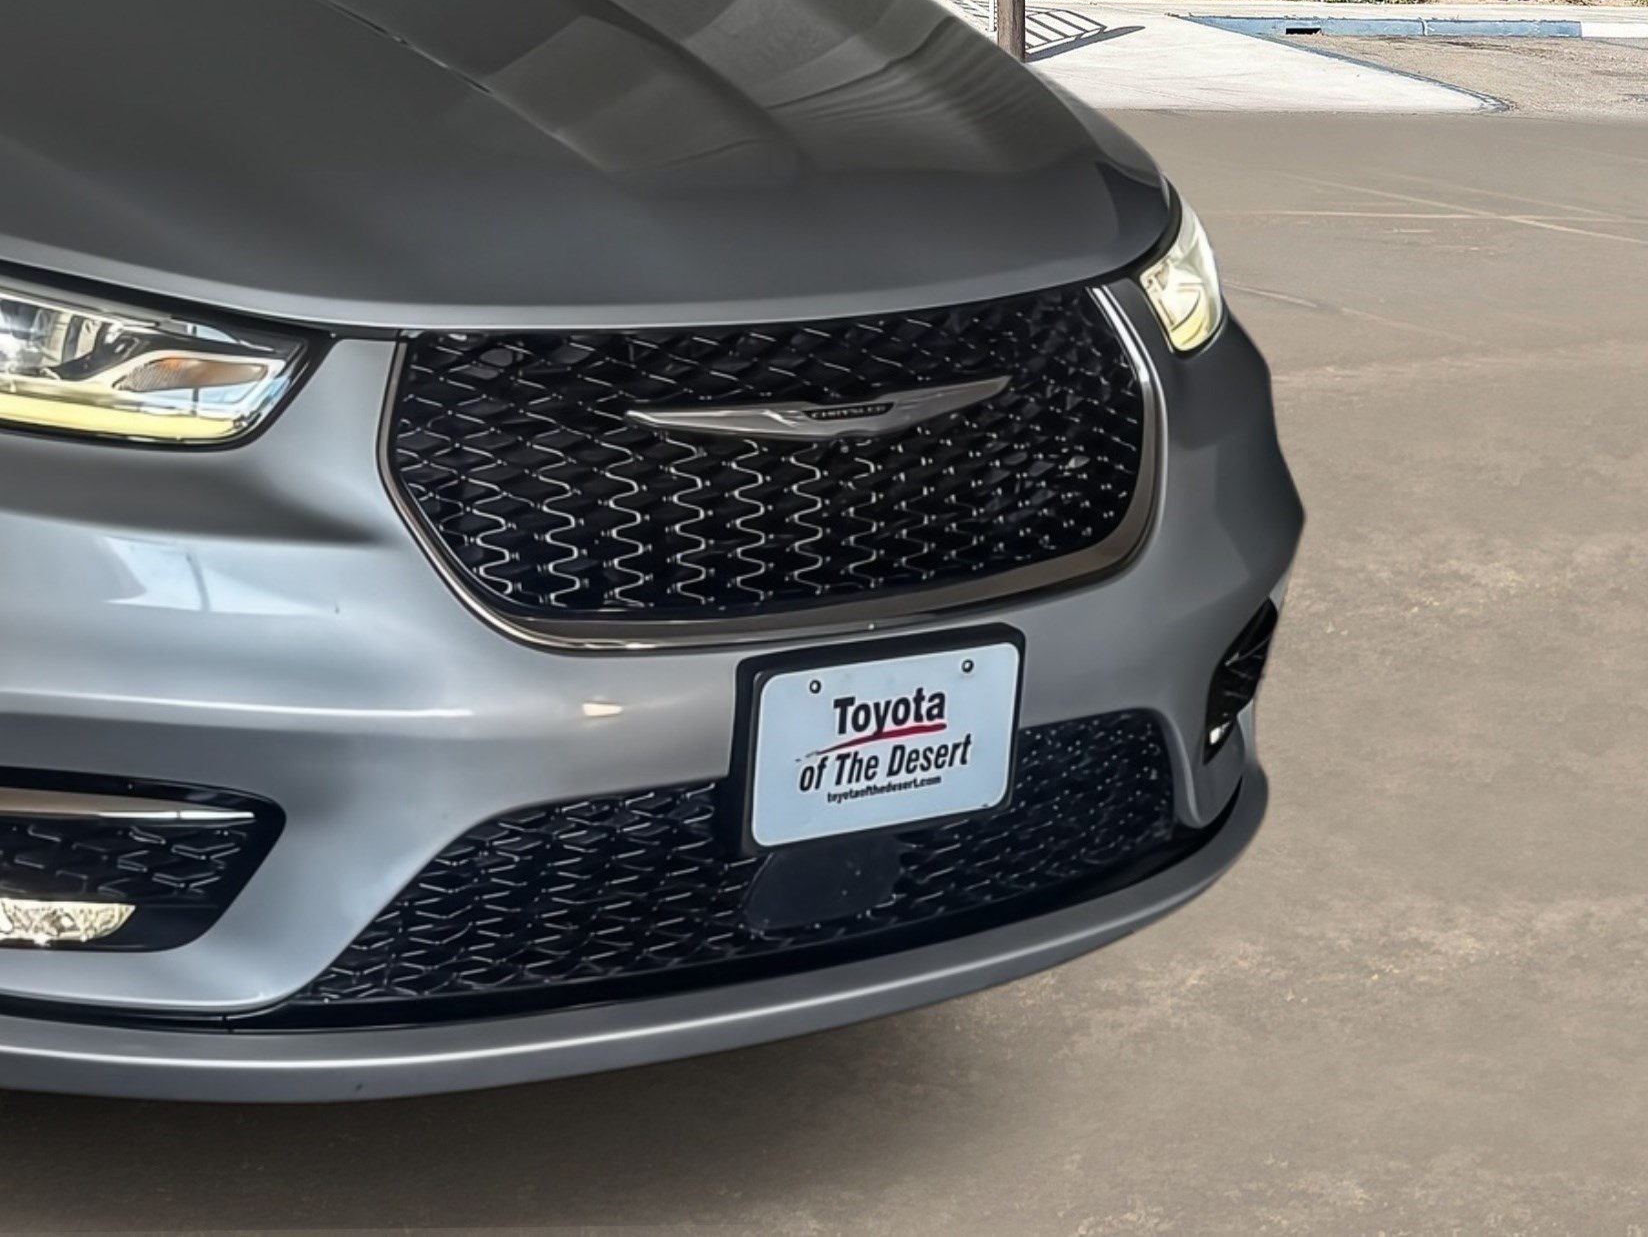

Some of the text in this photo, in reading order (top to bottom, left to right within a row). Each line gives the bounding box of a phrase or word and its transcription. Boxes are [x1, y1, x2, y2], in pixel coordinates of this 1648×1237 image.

[833, 687, 946, 736] Toyota
[799, 733, 972, 792] of The Desert
[827, 775, 942, 804] toyotaofthedesert.com
